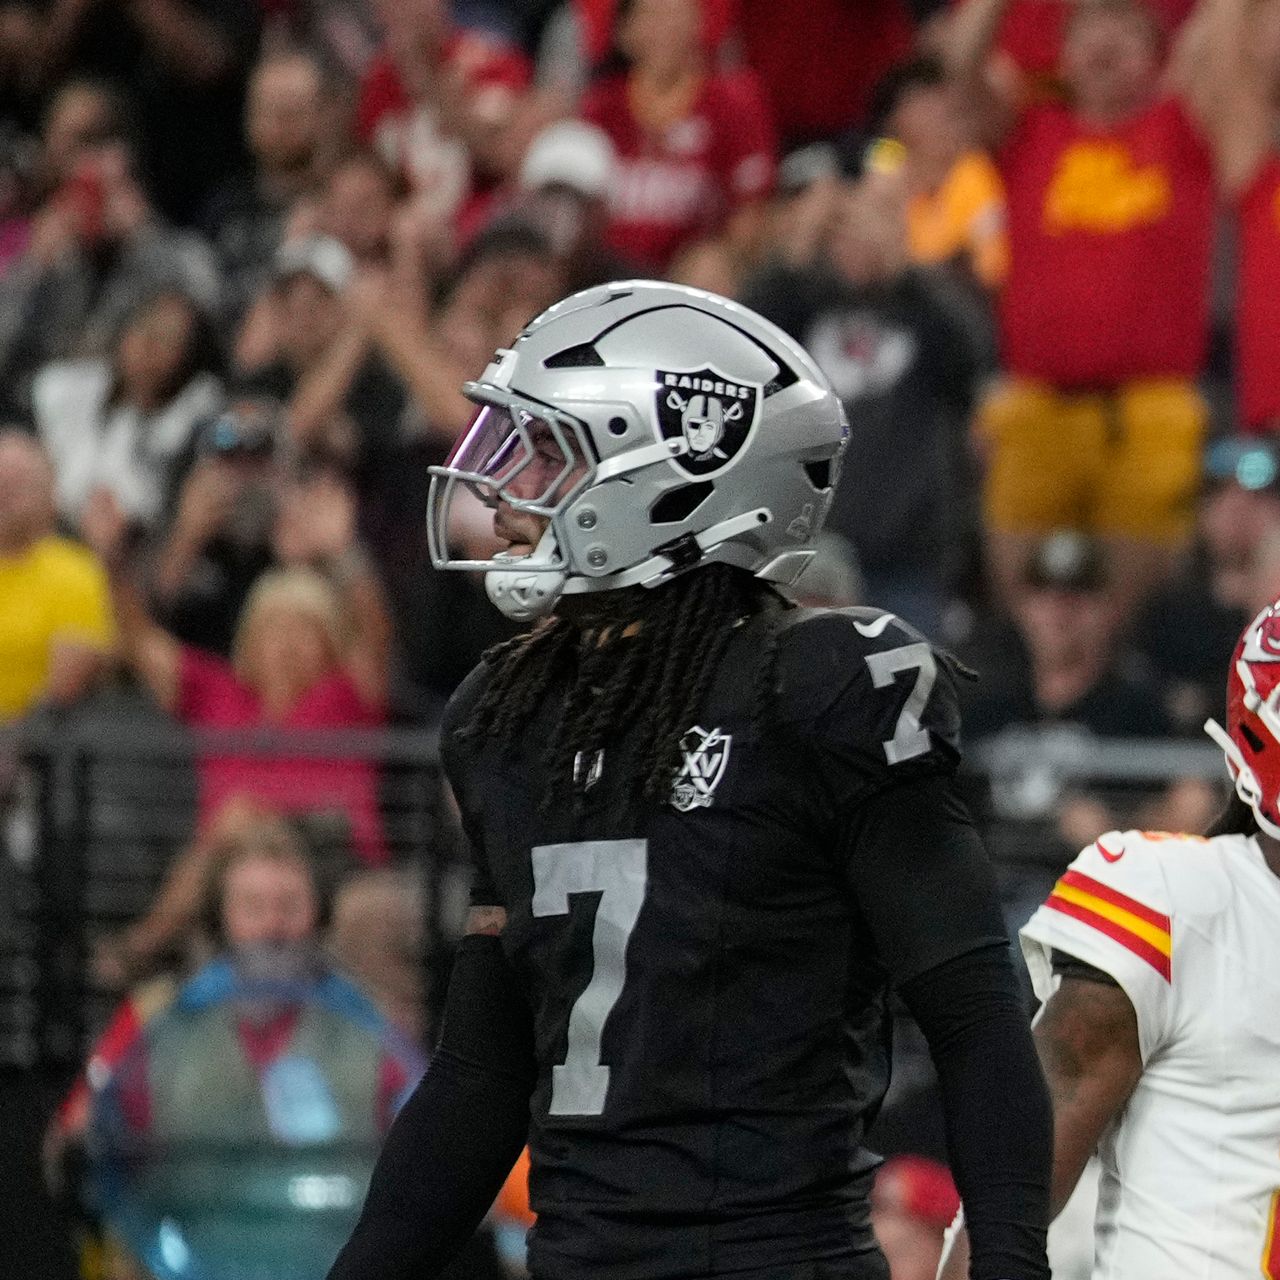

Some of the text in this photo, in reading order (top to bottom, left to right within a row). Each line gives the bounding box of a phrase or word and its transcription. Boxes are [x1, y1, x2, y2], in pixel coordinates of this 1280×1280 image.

[664, 373, 750, 399] RAIDERS
[864, 642, 937, 766] 7
[531, 838, 648, 1115] 7
